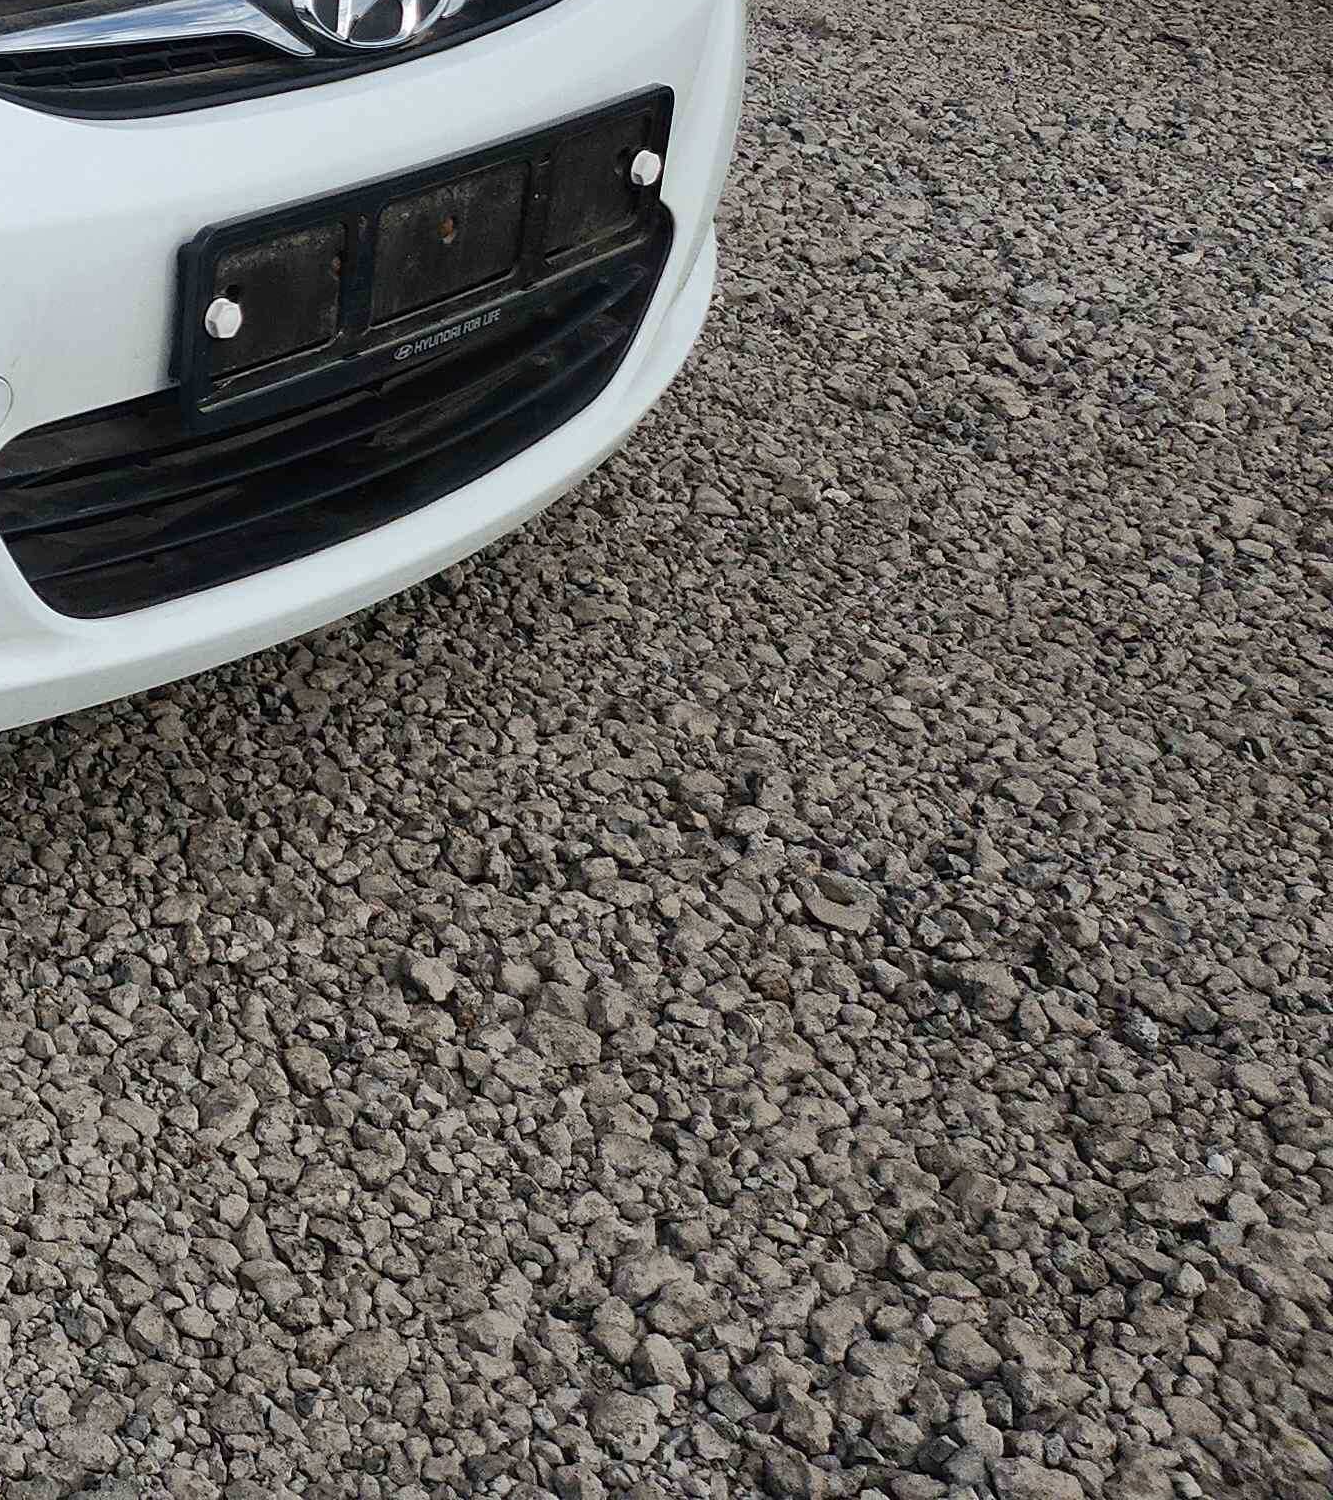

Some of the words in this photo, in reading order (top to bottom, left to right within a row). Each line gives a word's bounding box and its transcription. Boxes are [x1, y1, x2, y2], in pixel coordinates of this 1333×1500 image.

[414, 325, 462, 354] HYUNDAI
[463, 316, 481, 334] FOR
[482, 308, 501, 326] LIFE
